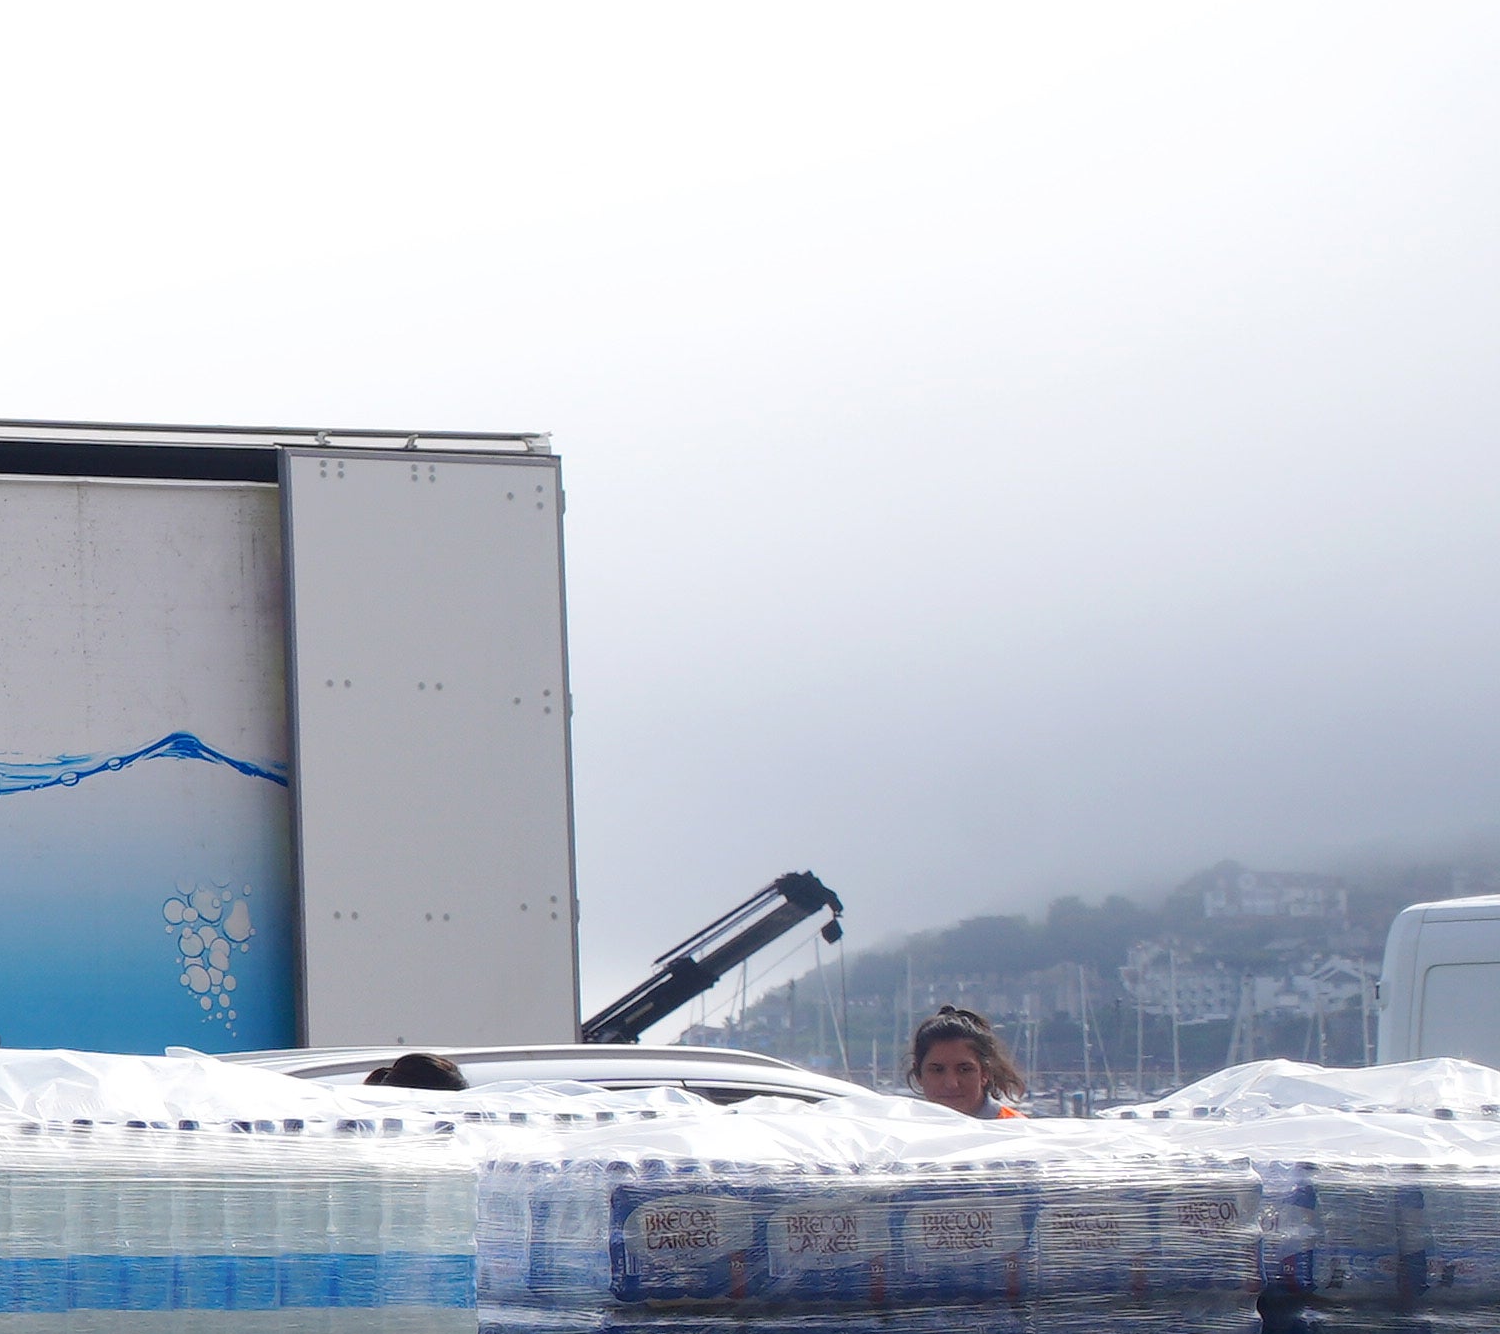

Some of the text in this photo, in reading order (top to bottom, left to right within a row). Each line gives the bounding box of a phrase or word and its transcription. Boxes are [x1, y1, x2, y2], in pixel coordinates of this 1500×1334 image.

[645, 1210, 717, 1229] BRECON
[787, 1216, 857, 1233] BRECON
[923, 1211, 993, 1229] BRECON
[646, 1230, 718, 1249] CARREG
